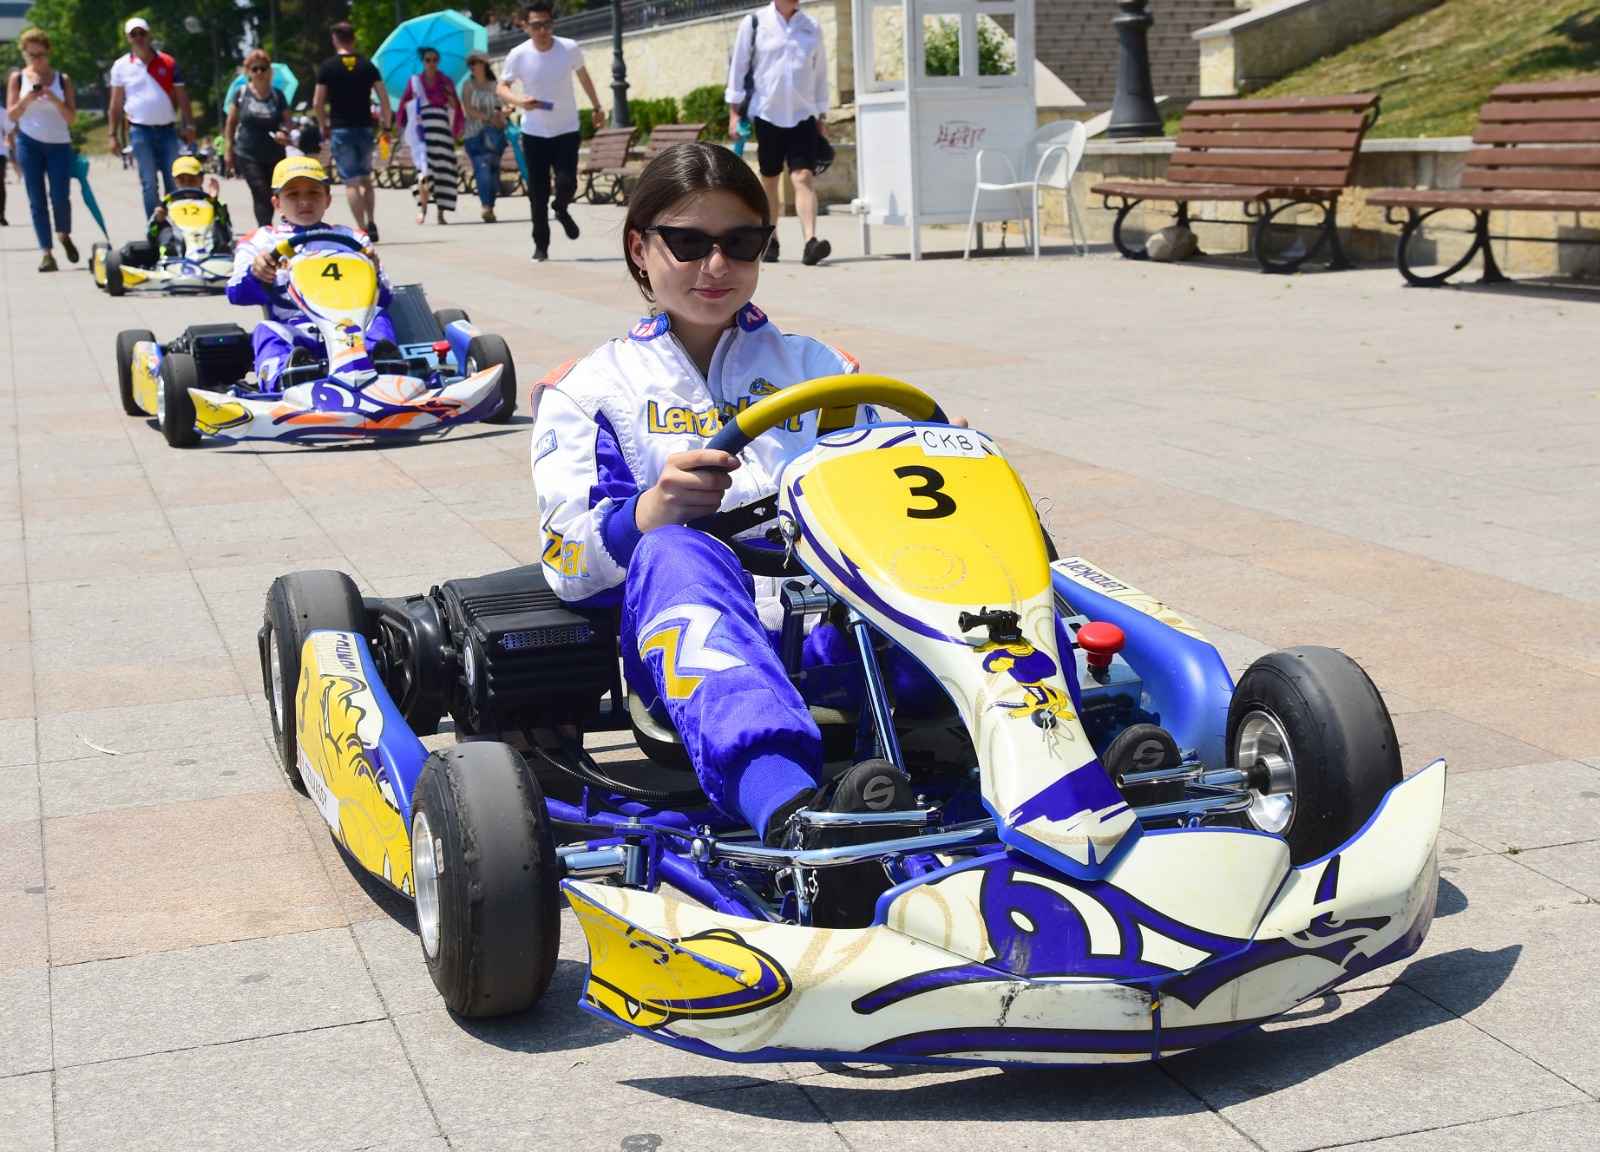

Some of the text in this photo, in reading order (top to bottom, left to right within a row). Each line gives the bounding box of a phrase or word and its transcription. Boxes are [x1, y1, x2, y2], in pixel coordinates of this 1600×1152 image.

[180, 206, 200, 216] 12
[321, 263, 343, 281] 4
[923, 430, 974, 451] CKB
[893, 465, 957, 520] 3
